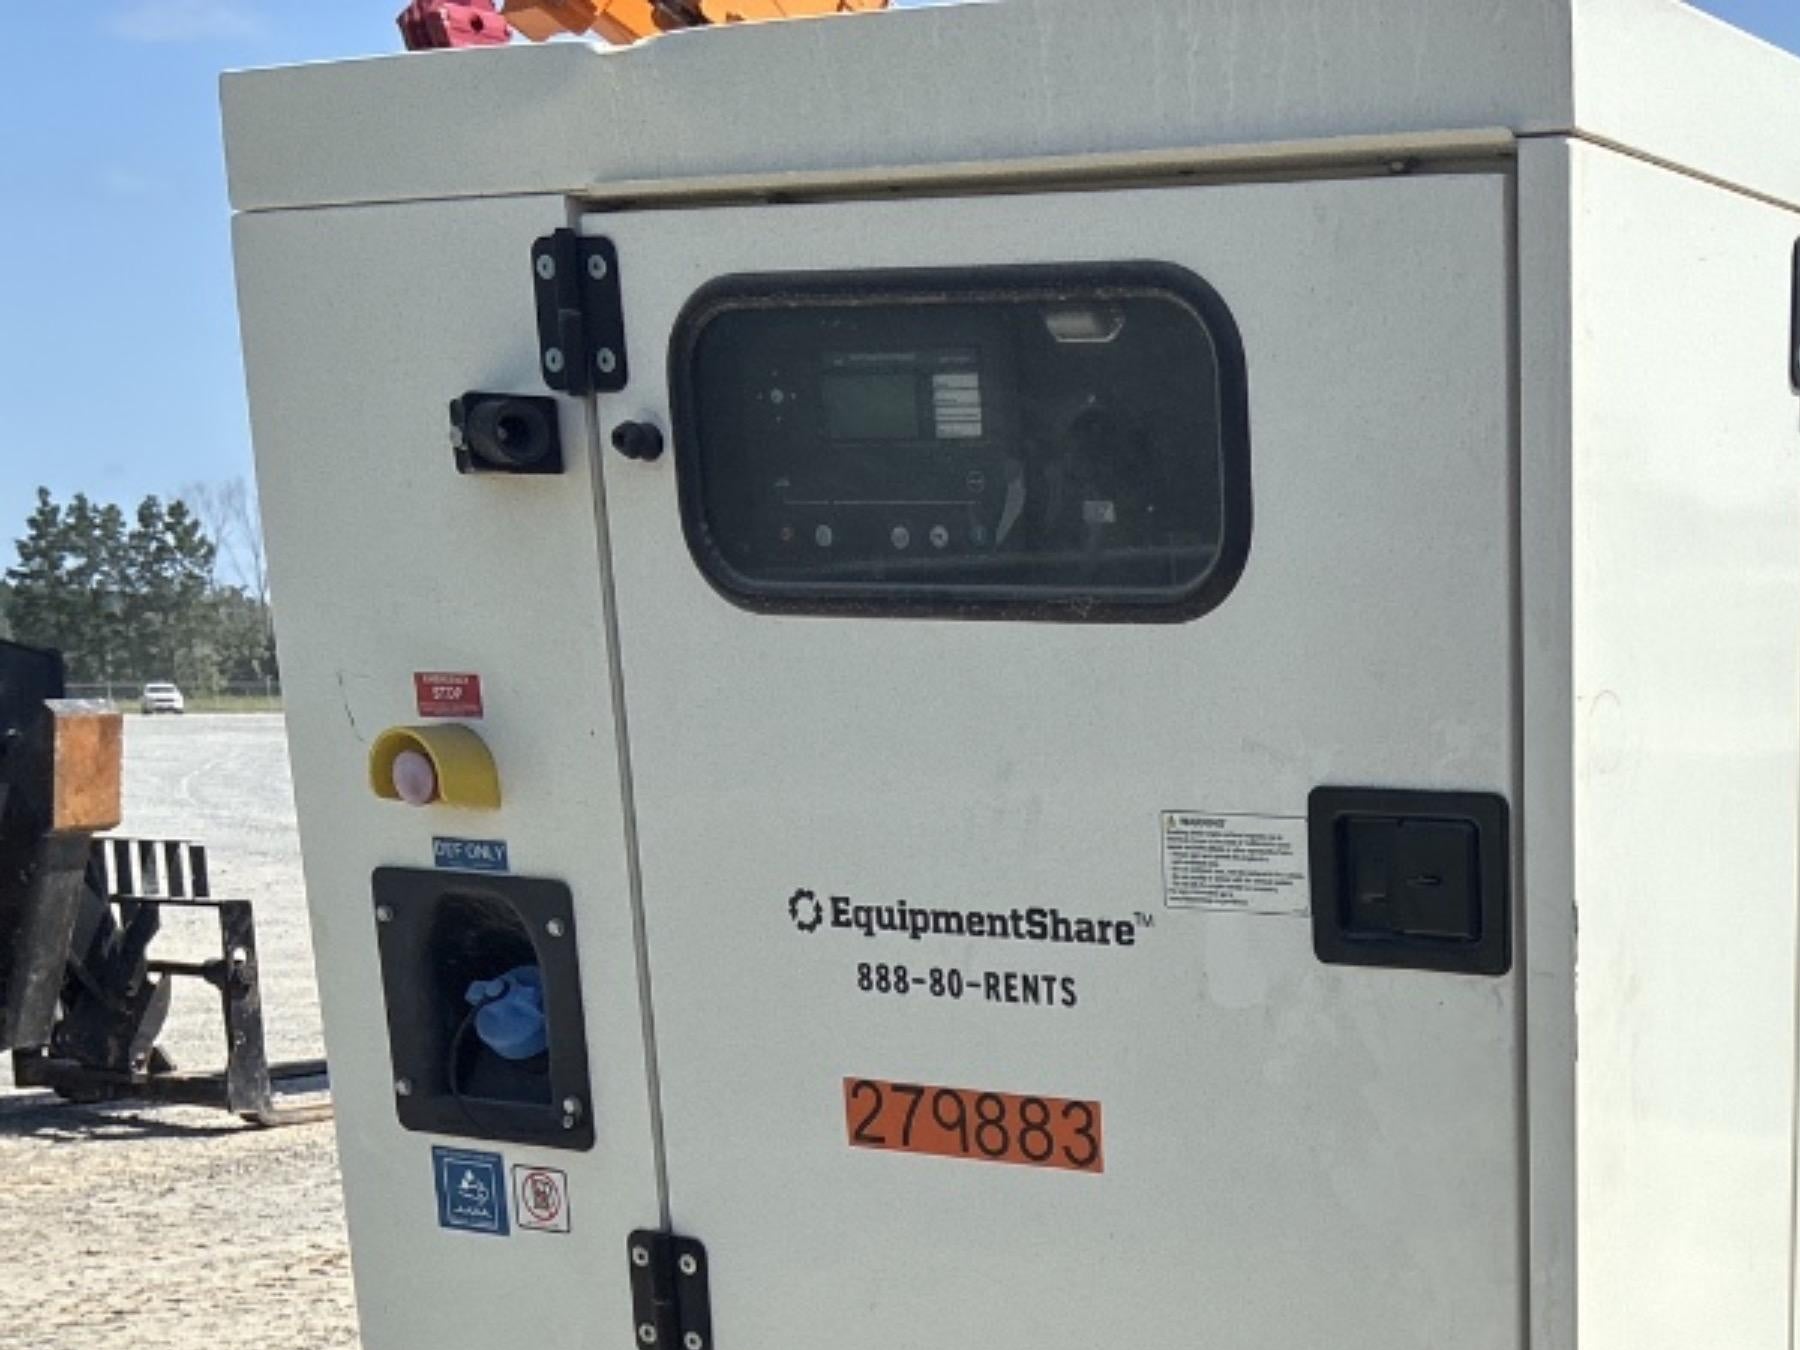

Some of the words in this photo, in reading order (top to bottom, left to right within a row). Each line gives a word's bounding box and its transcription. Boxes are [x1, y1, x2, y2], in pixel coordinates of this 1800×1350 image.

[434, 840, 463, 859] DEF
[464, 842, 505, 861] ONLY
[857, 962, 1077, 1007] 888-80-RENTS
[849, 1079, 1099, 1169] 279883
